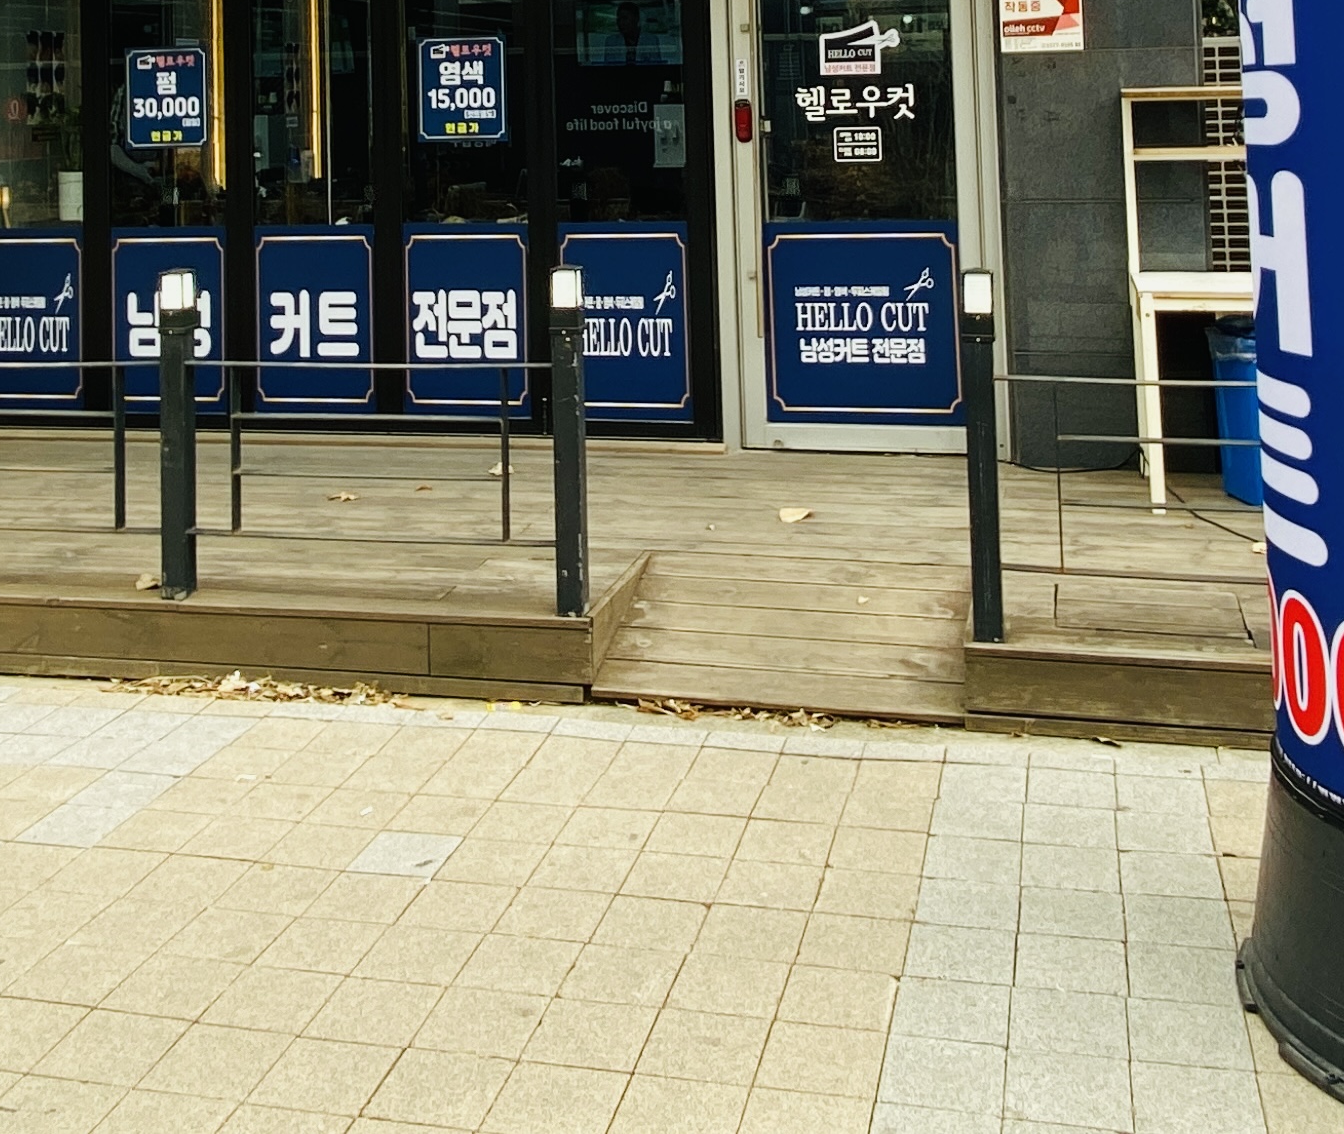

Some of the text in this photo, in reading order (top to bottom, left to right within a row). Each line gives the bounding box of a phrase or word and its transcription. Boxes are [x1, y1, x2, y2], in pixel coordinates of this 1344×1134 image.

[828, 48, 873, 59] HELLO CUT
[439, 60, 484, 85] 염색
[133, 96, 200, 120] 30,000
[427, 87, 496, 111] 15,000
[795, 84, 915, 121] 헬로우컷
[270, 289, 360, 357] 커트
[412, 288, 517, 359] 전문점
[795, 302, 929, 332] HELLO CUT
[39, 316, 70, 352] CUT
[637, 318, 673, 357] CUT
[799, 337, 926, 364] 남성커트 전문점
